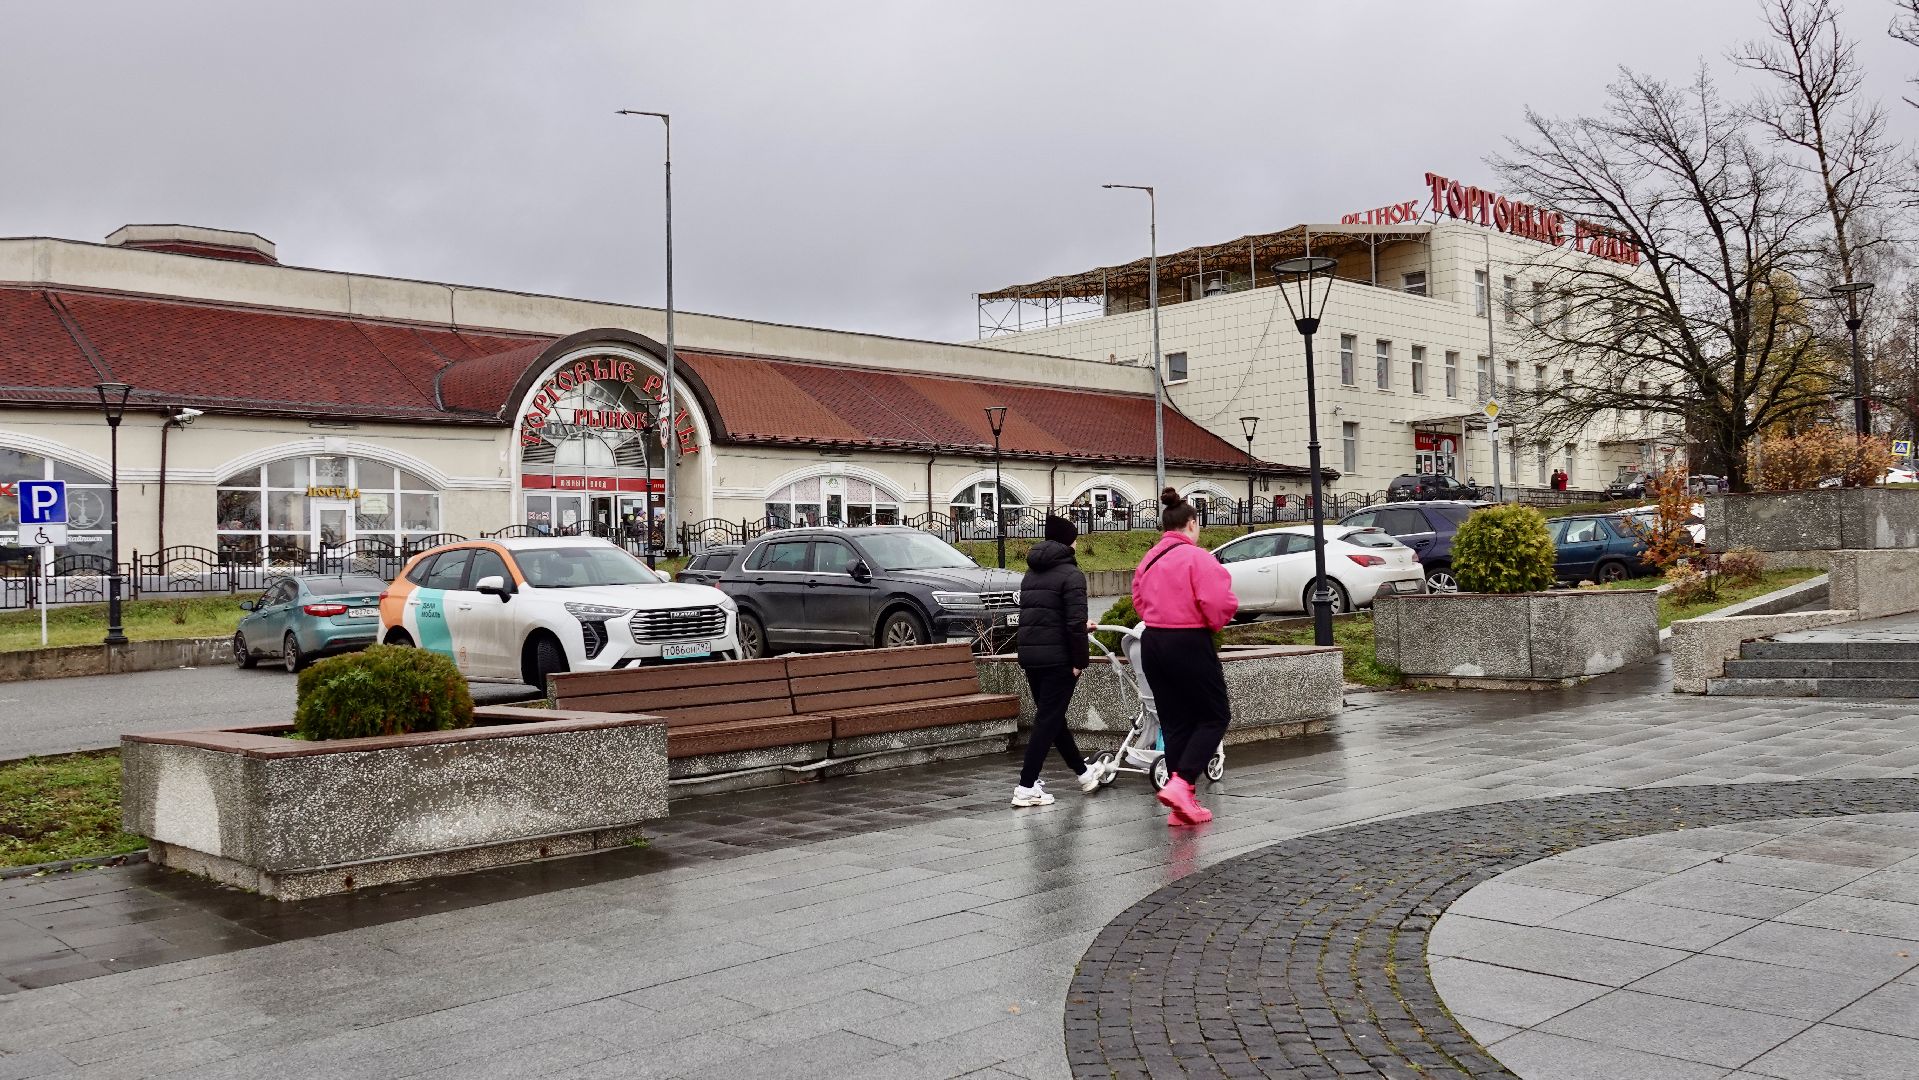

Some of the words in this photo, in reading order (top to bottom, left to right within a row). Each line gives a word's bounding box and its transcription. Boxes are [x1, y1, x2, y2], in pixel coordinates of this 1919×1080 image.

[1425, 172, 1566, 247] ТОРГОВЫЕ
[521, 359, 636, 446] ТОРГОВЫЕ
[573, 408, 649, 431] РЫНОК
[31, 485, 58, 519] P
[306, 487, 361, 499] ПОСУДА
